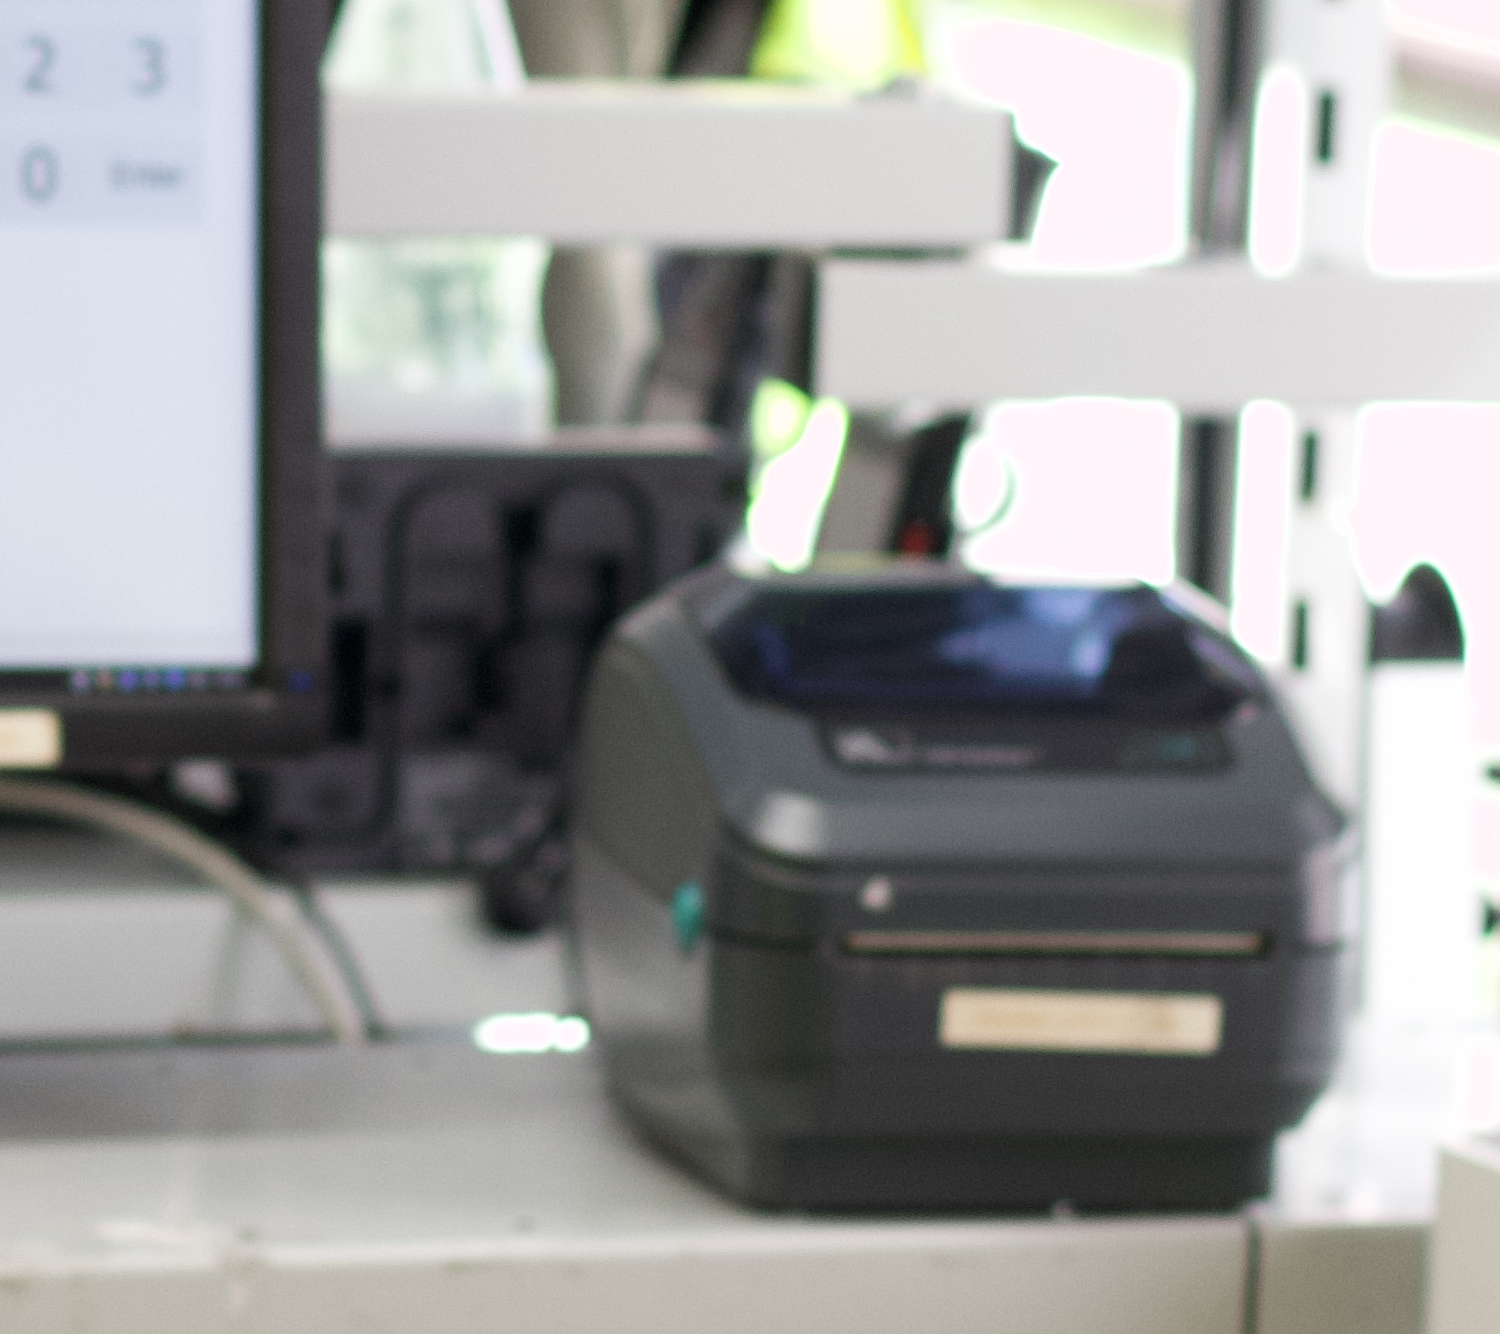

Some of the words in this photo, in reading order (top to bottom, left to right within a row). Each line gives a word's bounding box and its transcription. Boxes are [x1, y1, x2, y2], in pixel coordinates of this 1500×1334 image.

[22, 34, 56, 94] 2
[131, 36, 167, 96] 3
[19, 144, 59, 204] 0
